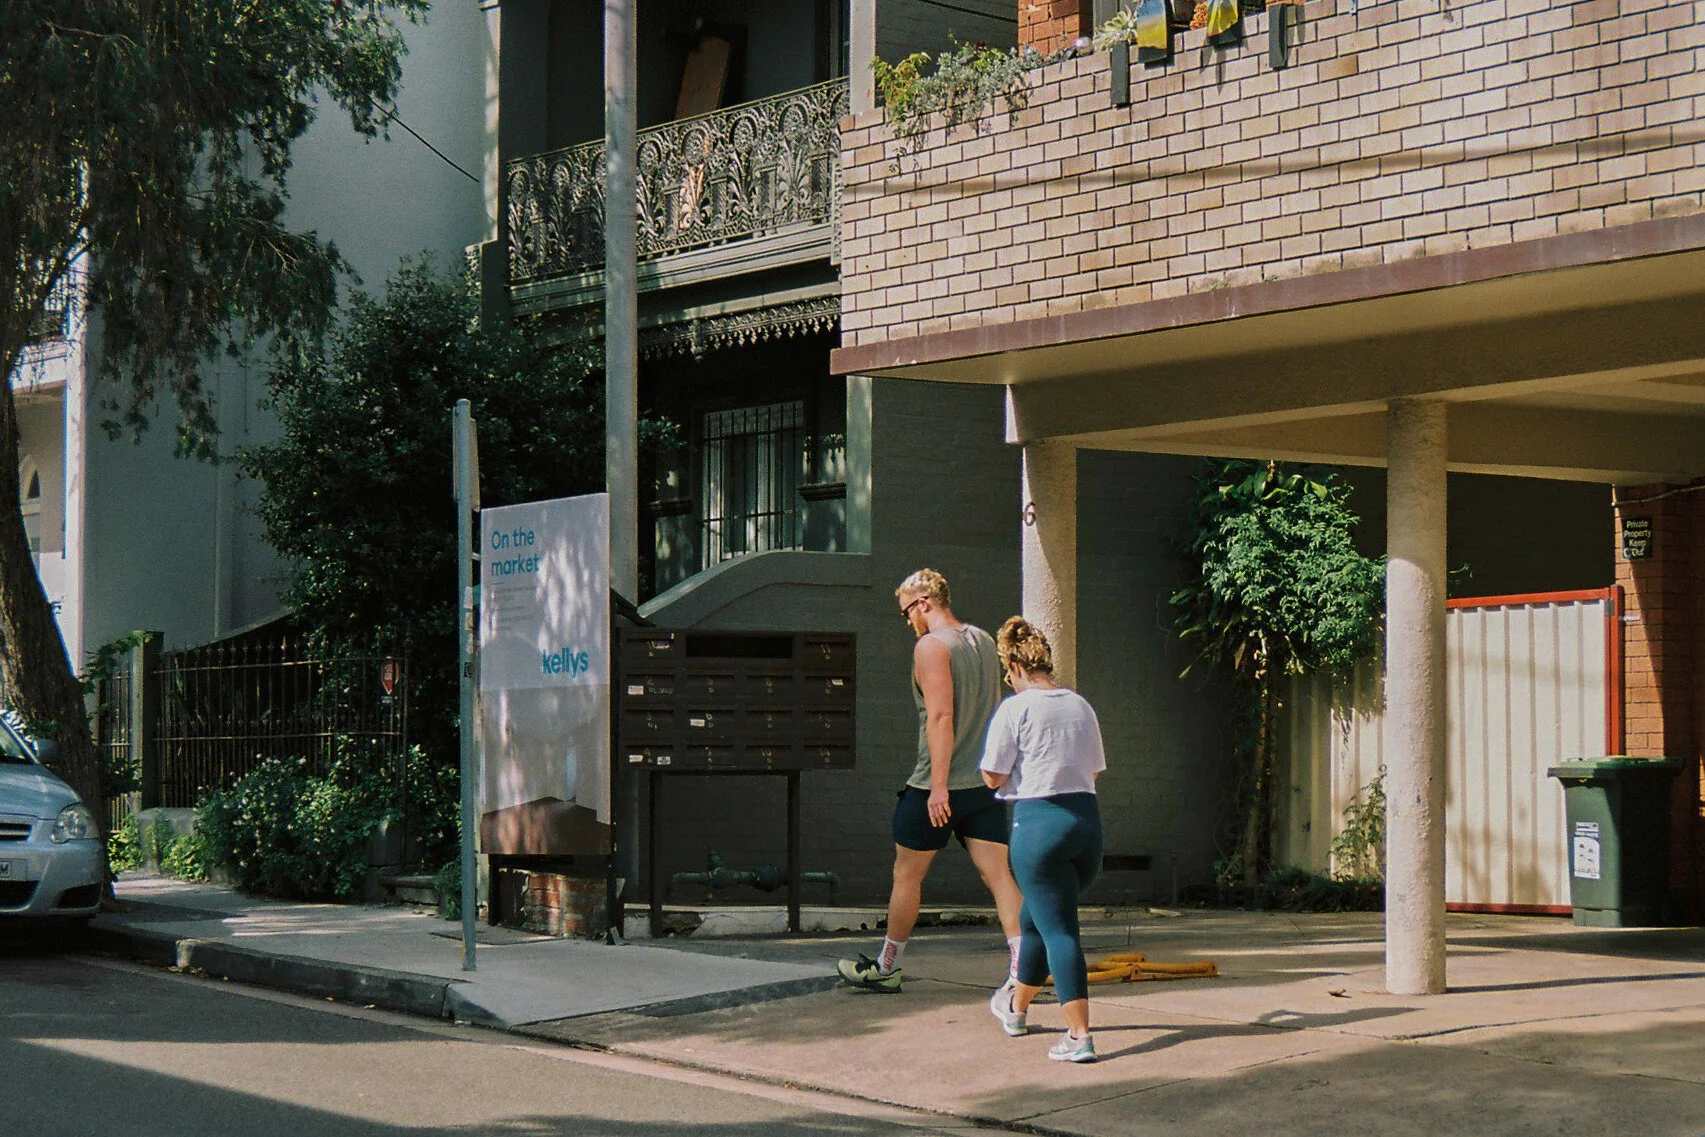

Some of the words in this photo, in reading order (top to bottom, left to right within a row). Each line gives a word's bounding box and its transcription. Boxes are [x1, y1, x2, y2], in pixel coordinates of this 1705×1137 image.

[1024, 502, 1036, 527] 6
[1627, 520, 1648, 528] Private
[492, 531, 509, 549] On
[513, 527, 534, 546] the
[1624, 530, 1651, 538] Property
[1629, 539, 1646, 547] Keep
[491, 553, 539, 576] market
[543, 647, 589, 678] kellys
